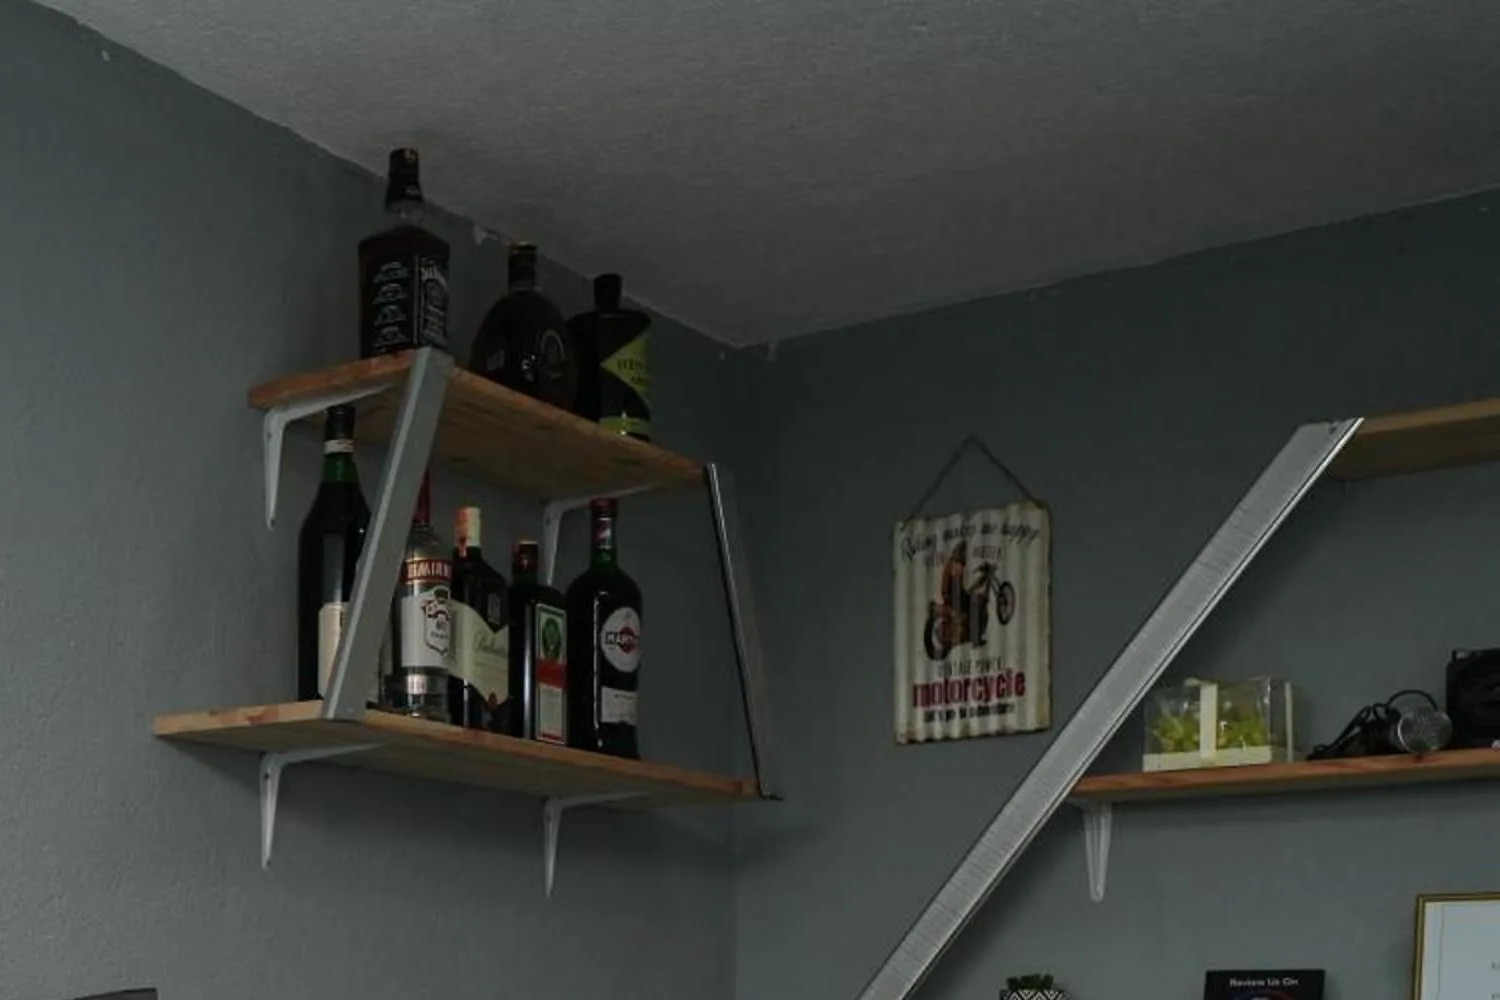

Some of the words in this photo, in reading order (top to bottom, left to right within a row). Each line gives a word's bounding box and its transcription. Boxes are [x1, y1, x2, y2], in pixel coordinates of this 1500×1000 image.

[1229, 977, 1265, 988] Review
[1267, 977, 1281, 987] Us
[1282, 977, 1299, 986] On
